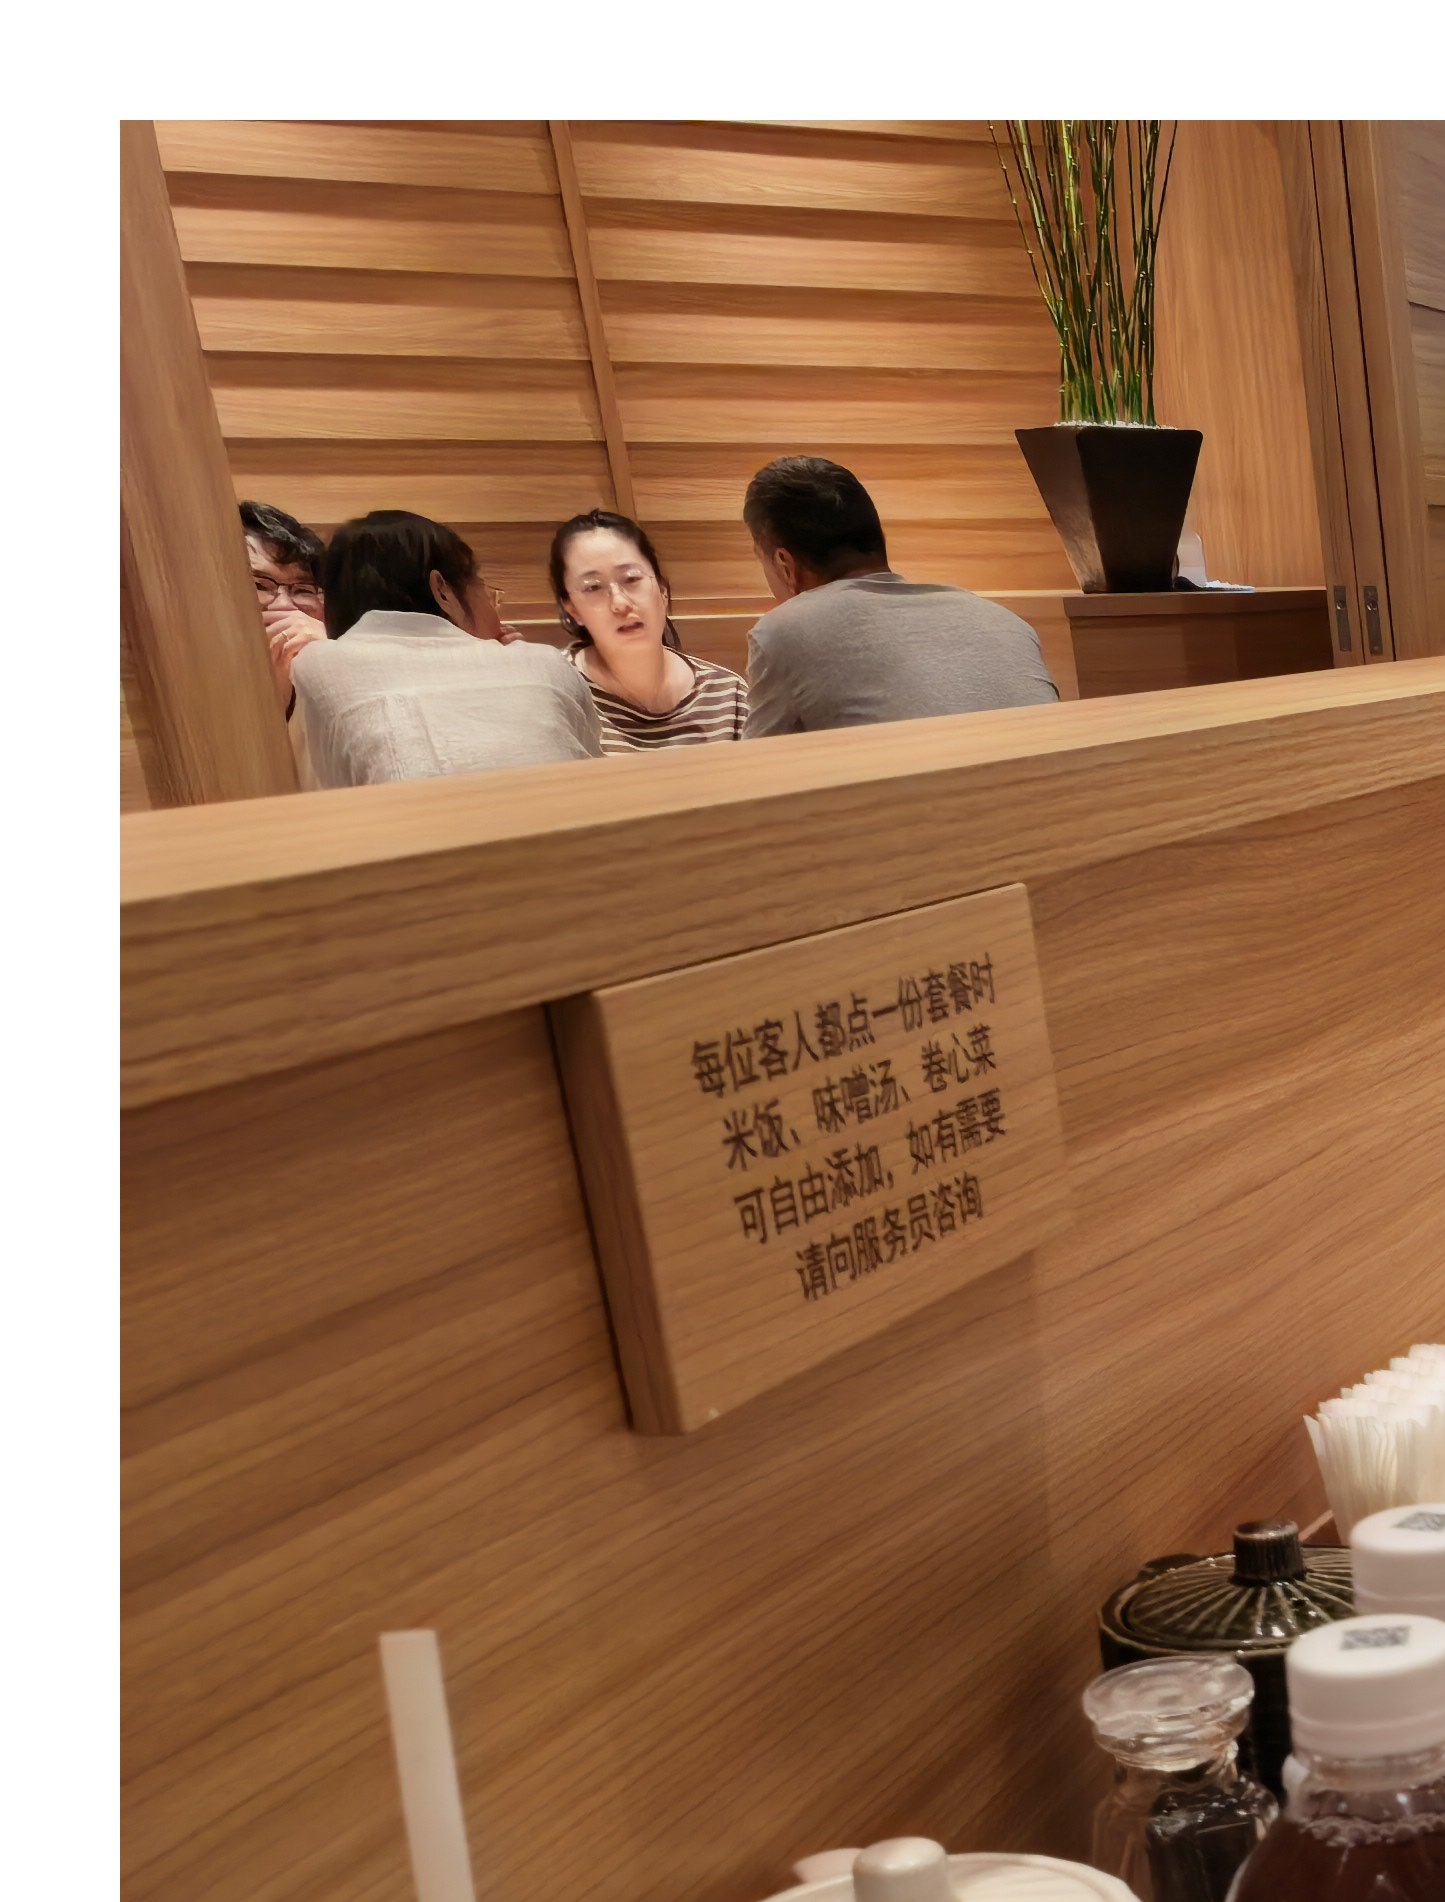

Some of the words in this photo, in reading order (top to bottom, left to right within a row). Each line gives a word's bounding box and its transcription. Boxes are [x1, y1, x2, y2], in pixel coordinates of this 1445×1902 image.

[691, 952, 995, 1098] 每位客人都点一份套餐时
[796, 1172, 983, 1301] 请向服务员咨询
